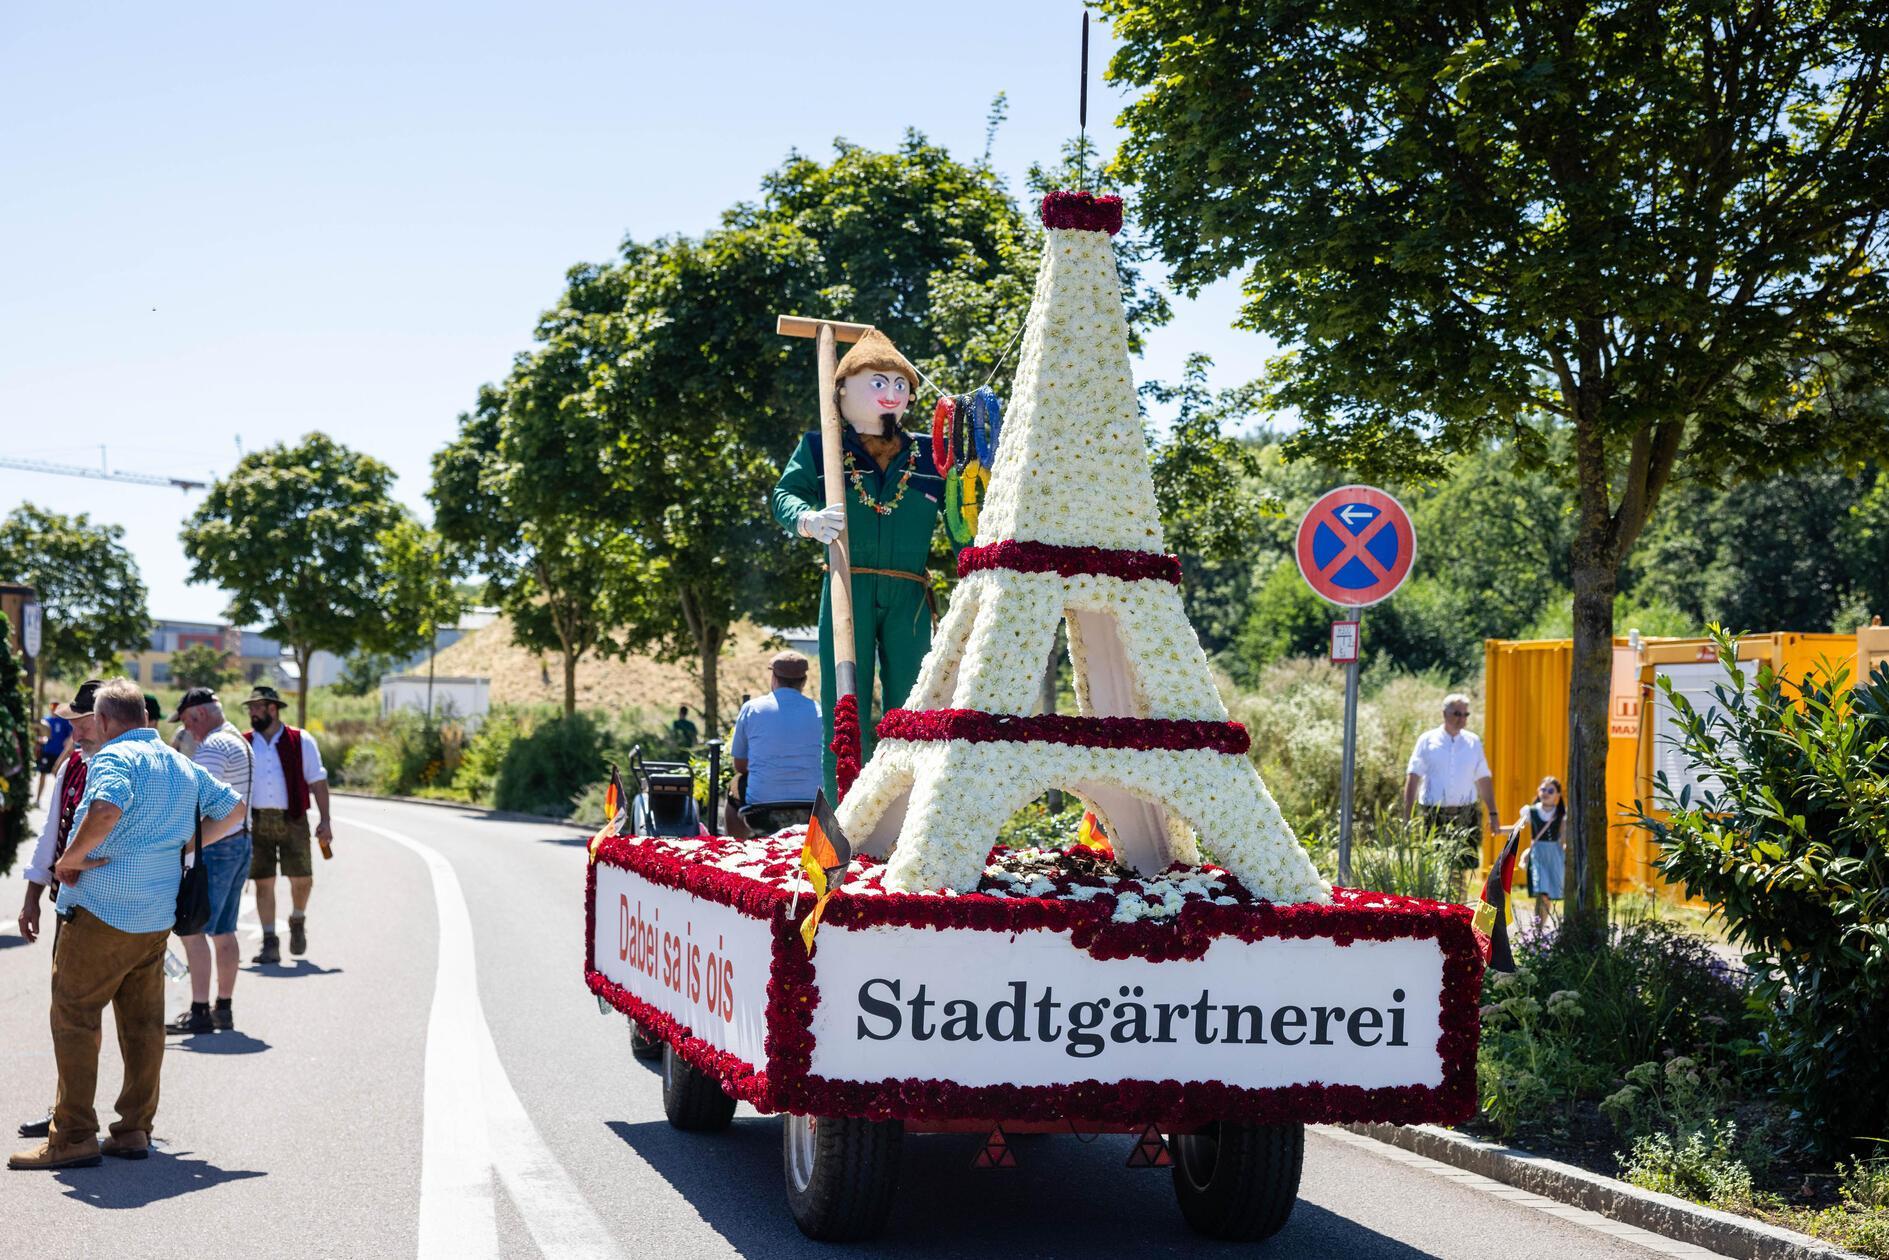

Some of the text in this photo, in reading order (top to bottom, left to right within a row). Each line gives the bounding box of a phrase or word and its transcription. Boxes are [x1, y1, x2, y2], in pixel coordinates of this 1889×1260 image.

[619, 893, 734, 1023] Dabei sa is ois
[857, 978, 1408, 1057] Stadtgärtnerei
